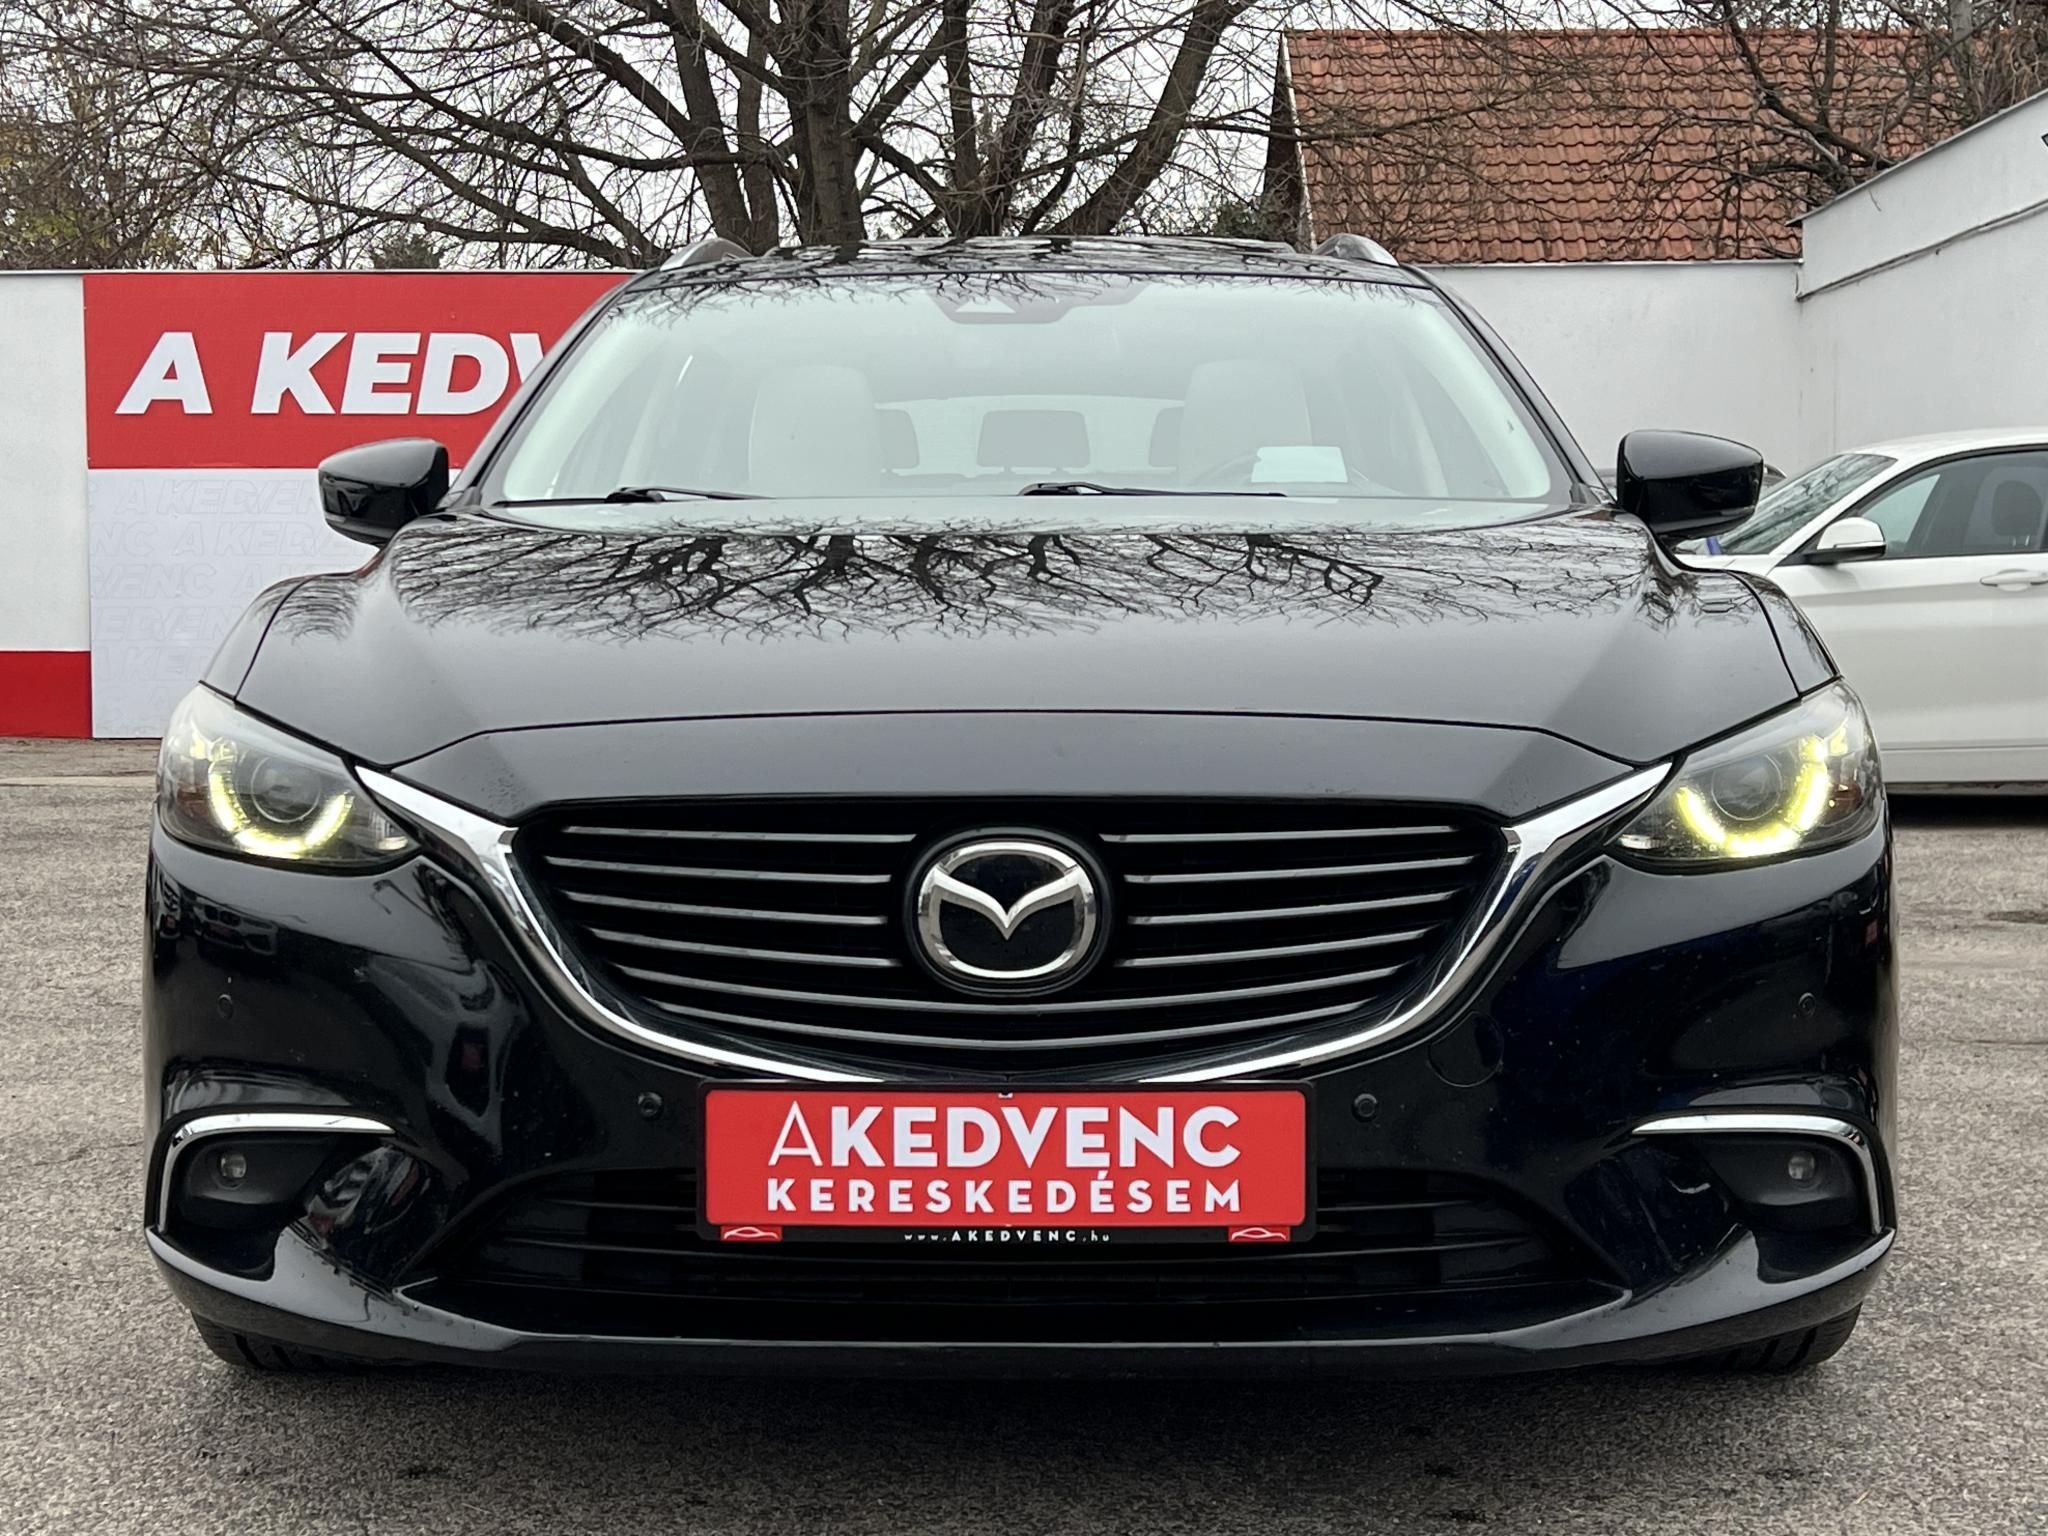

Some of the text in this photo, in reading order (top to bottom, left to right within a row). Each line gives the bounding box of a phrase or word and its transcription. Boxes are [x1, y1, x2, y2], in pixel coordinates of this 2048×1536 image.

[115, 332, 213, 414] A
[767, 1171, 1241, 1213] KERESKEDÉSEM
[903, 1229, 1111, 1243] www.AKEDVENC.hu
